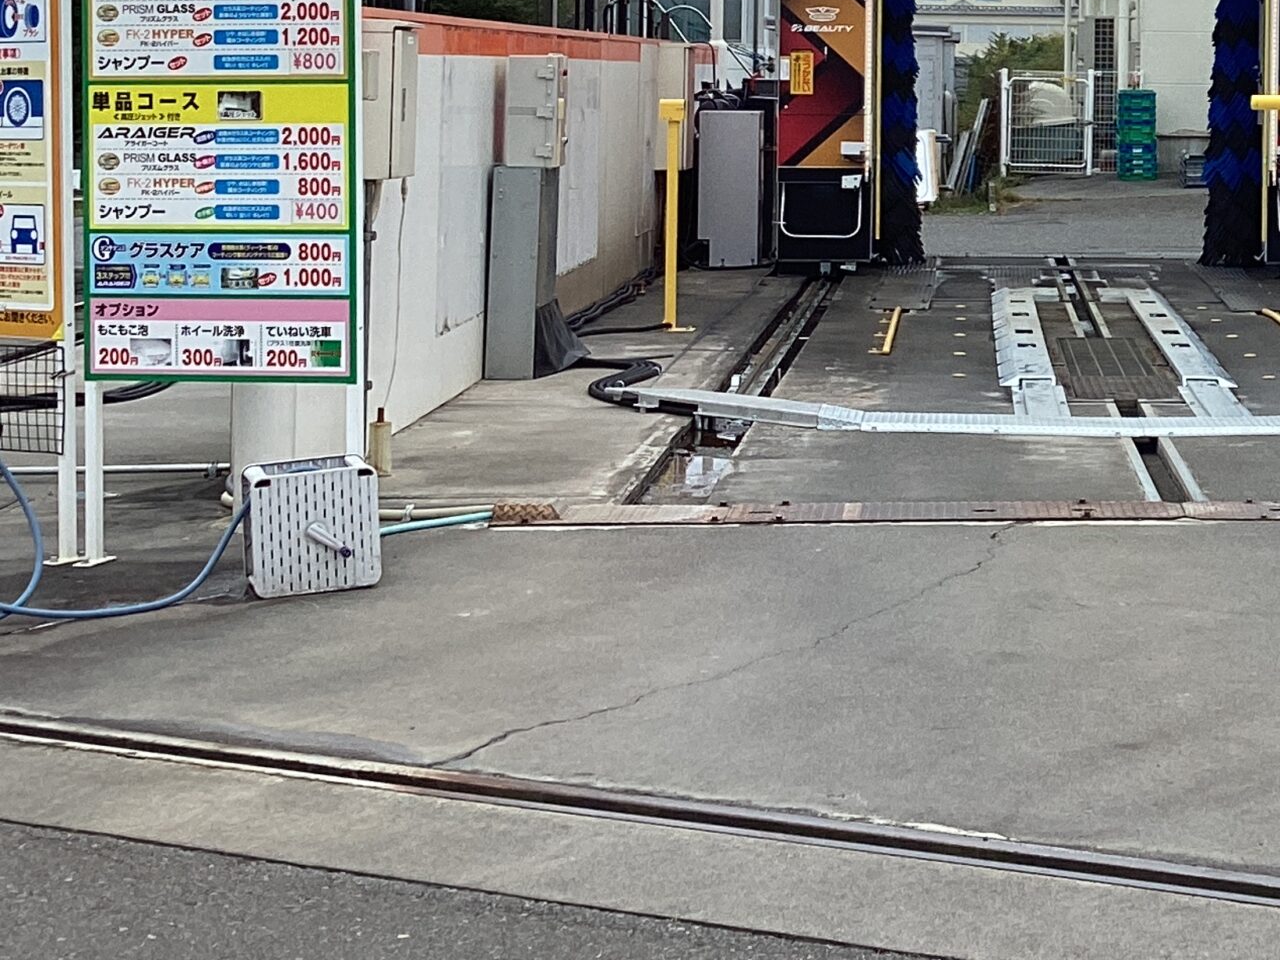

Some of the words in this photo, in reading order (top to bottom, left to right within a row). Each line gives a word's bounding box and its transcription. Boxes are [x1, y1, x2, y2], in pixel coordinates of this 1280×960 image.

[122, 4, 154, 14] PRISM
[156, 4, 196, 14] GLASS
[193, 10, 212, 20] セット
[280, 2, 340, 21] 2,000円
[126, 30, 150, 39] FK-2
[152, 29, 195, 39] HYPER
[804, 24, 855, 33] BEAUTY
[193, 35, 212, 45] セット
[281, 27, 340, 46] 1,200円
[97, 55, 165, 70] シャンプー
[169, 57, 187, 68] セット
[293, 52, 337, 70] ¥800
[92, 92, 200, 111] 単品コース
[97, 126, 196, 139] ARAIGER
[281, 127, 340, 146] 2,000円
[123, 153, 155, 163] PRISM
[157, 153, 197, 163] GLASS
[282, 152, 341, 171] 1,600円
[127, 178, 152, 188] FK-2
[153, 178, 196, 188] HYPER
[298, 178, 341, 196] 800円
[98, 205, 166, 218] シャンプー
[295, 203, 339, 219] ¥400
[129, 242, 205, 258] グラスケア
[298, 243, 341, 261] 800円
[258, 273, 276, 285] セット
[283, 268, 342, 287] 1,000円
[95, 303, 159, 318] オプション
[97, 324, 149, 337] もこもこ泡
[180, 325, 245, 338] ホイール洗浄
[266, 325, 332, 338] ていねい洗車
[99, 347, 139, 366] 200円
[182, 348, 222, 367] 300円
[266, 349, 307, 368] 200円
